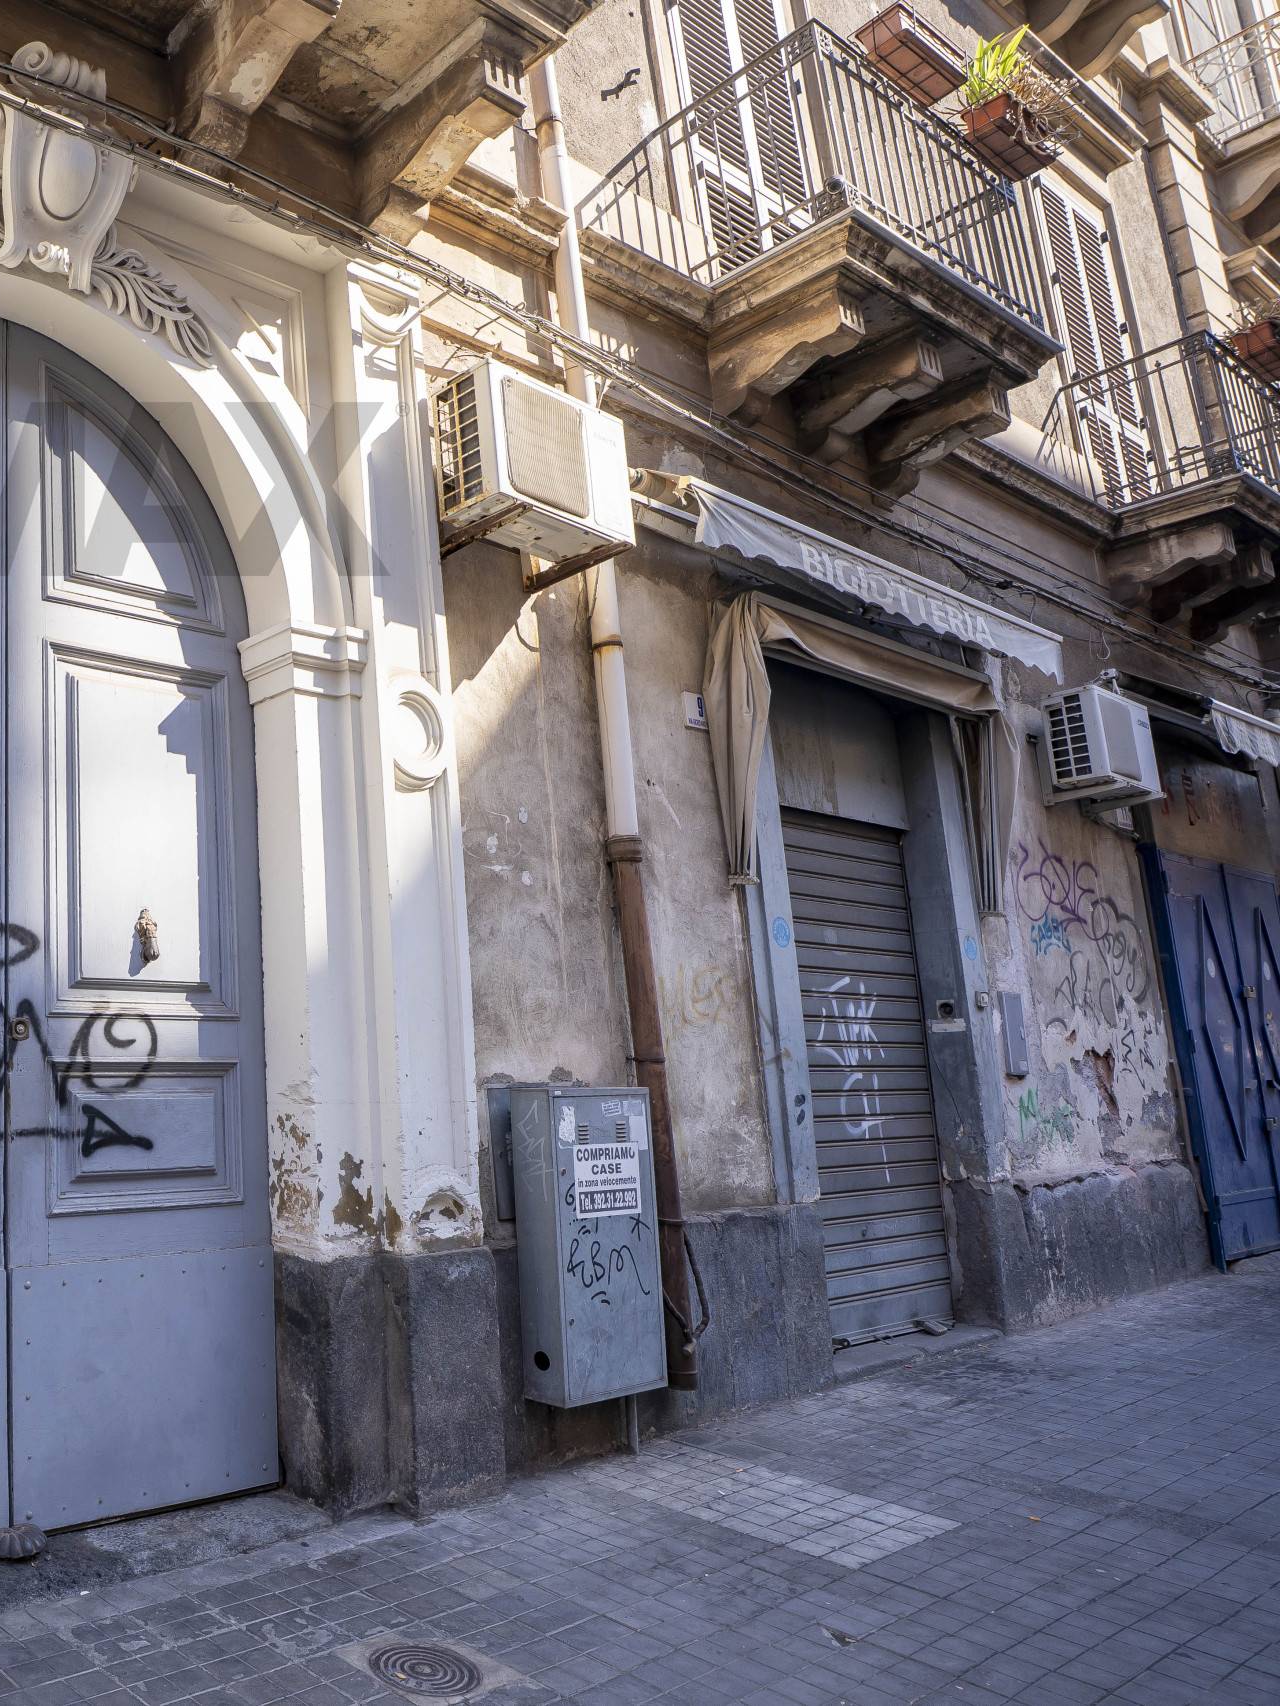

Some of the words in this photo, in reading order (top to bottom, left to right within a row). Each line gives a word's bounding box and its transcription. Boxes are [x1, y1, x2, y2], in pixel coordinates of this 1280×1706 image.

[799, 541, 997, 648] BIGIOTTERIA
[576, 1147, 635, 1162] COMPRIAMO
[591, 1163, 622, 1176] CASE
[578, 1178, 584, 1188] in
[585, 1179, 599, 1188] zona
[600, 1175, 637, 1187] velocemente
[580, 1194, 593, 1211] Tel.
